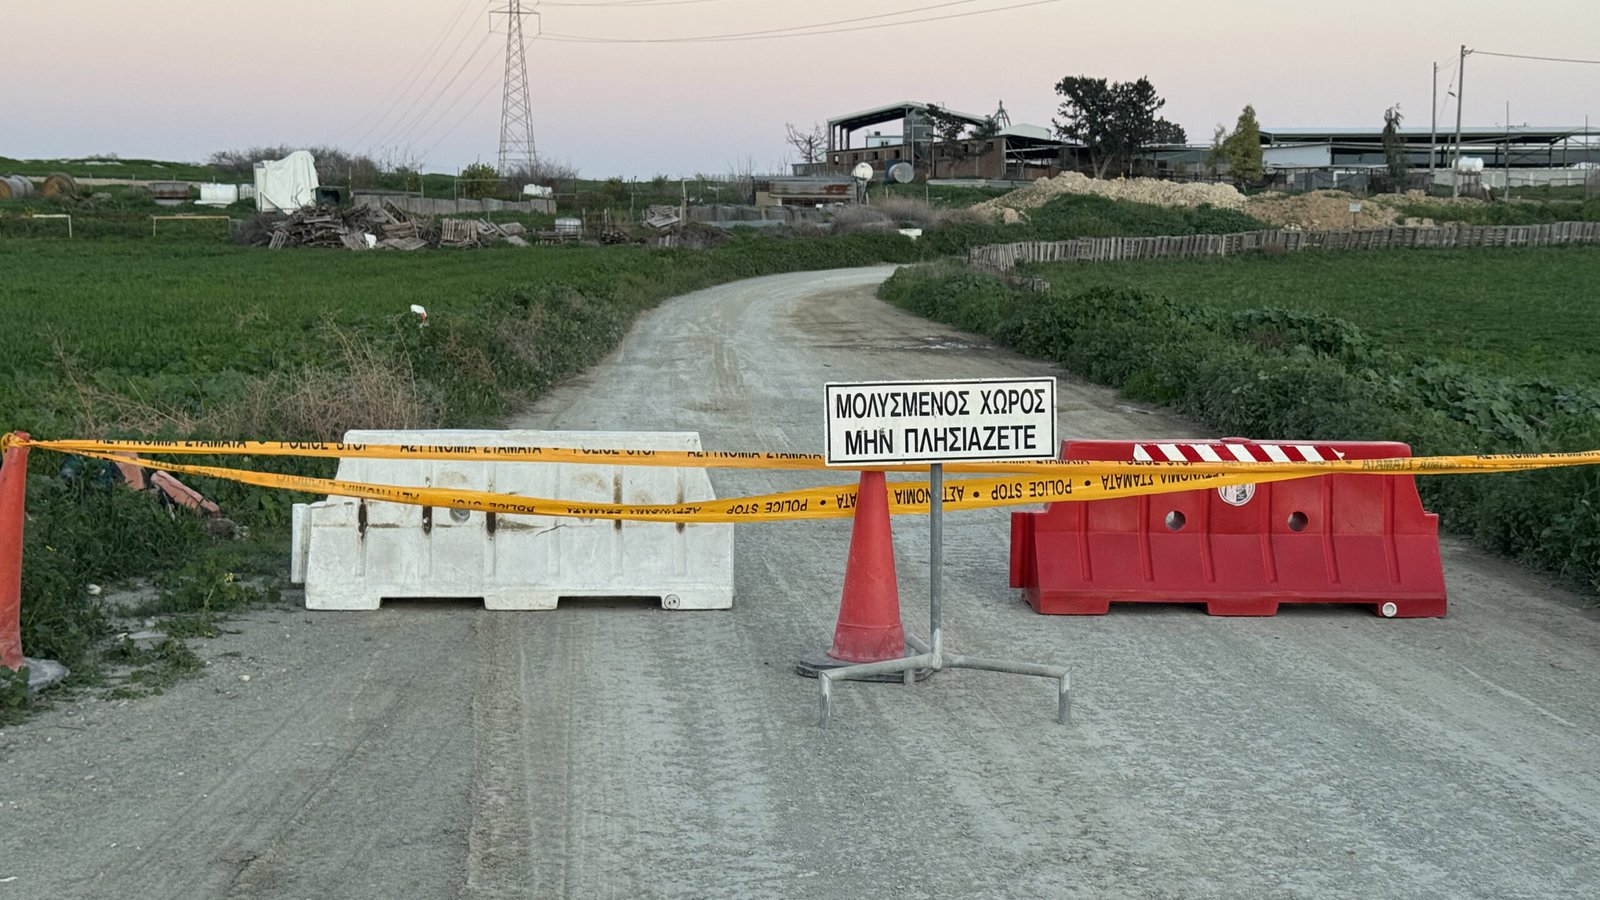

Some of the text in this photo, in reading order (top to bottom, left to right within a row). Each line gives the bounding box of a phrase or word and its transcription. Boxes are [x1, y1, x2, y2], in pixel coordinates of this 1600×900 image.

[836, 388, 1046, 419] ΜΟΛΥΣΜΕΝΟΣ ΧΩΡΟΣ
[845, 424, 1037, 456] ΜΗΝ ΠΛΗΣΙΑΖΕΤΕ
[894, 485, 965, 505] ΑΣΤΝΟΜΙΑ
[991, 478, 1072, 501] POLICE STOP
[726, 498, 809, 515] POLICE STOP
